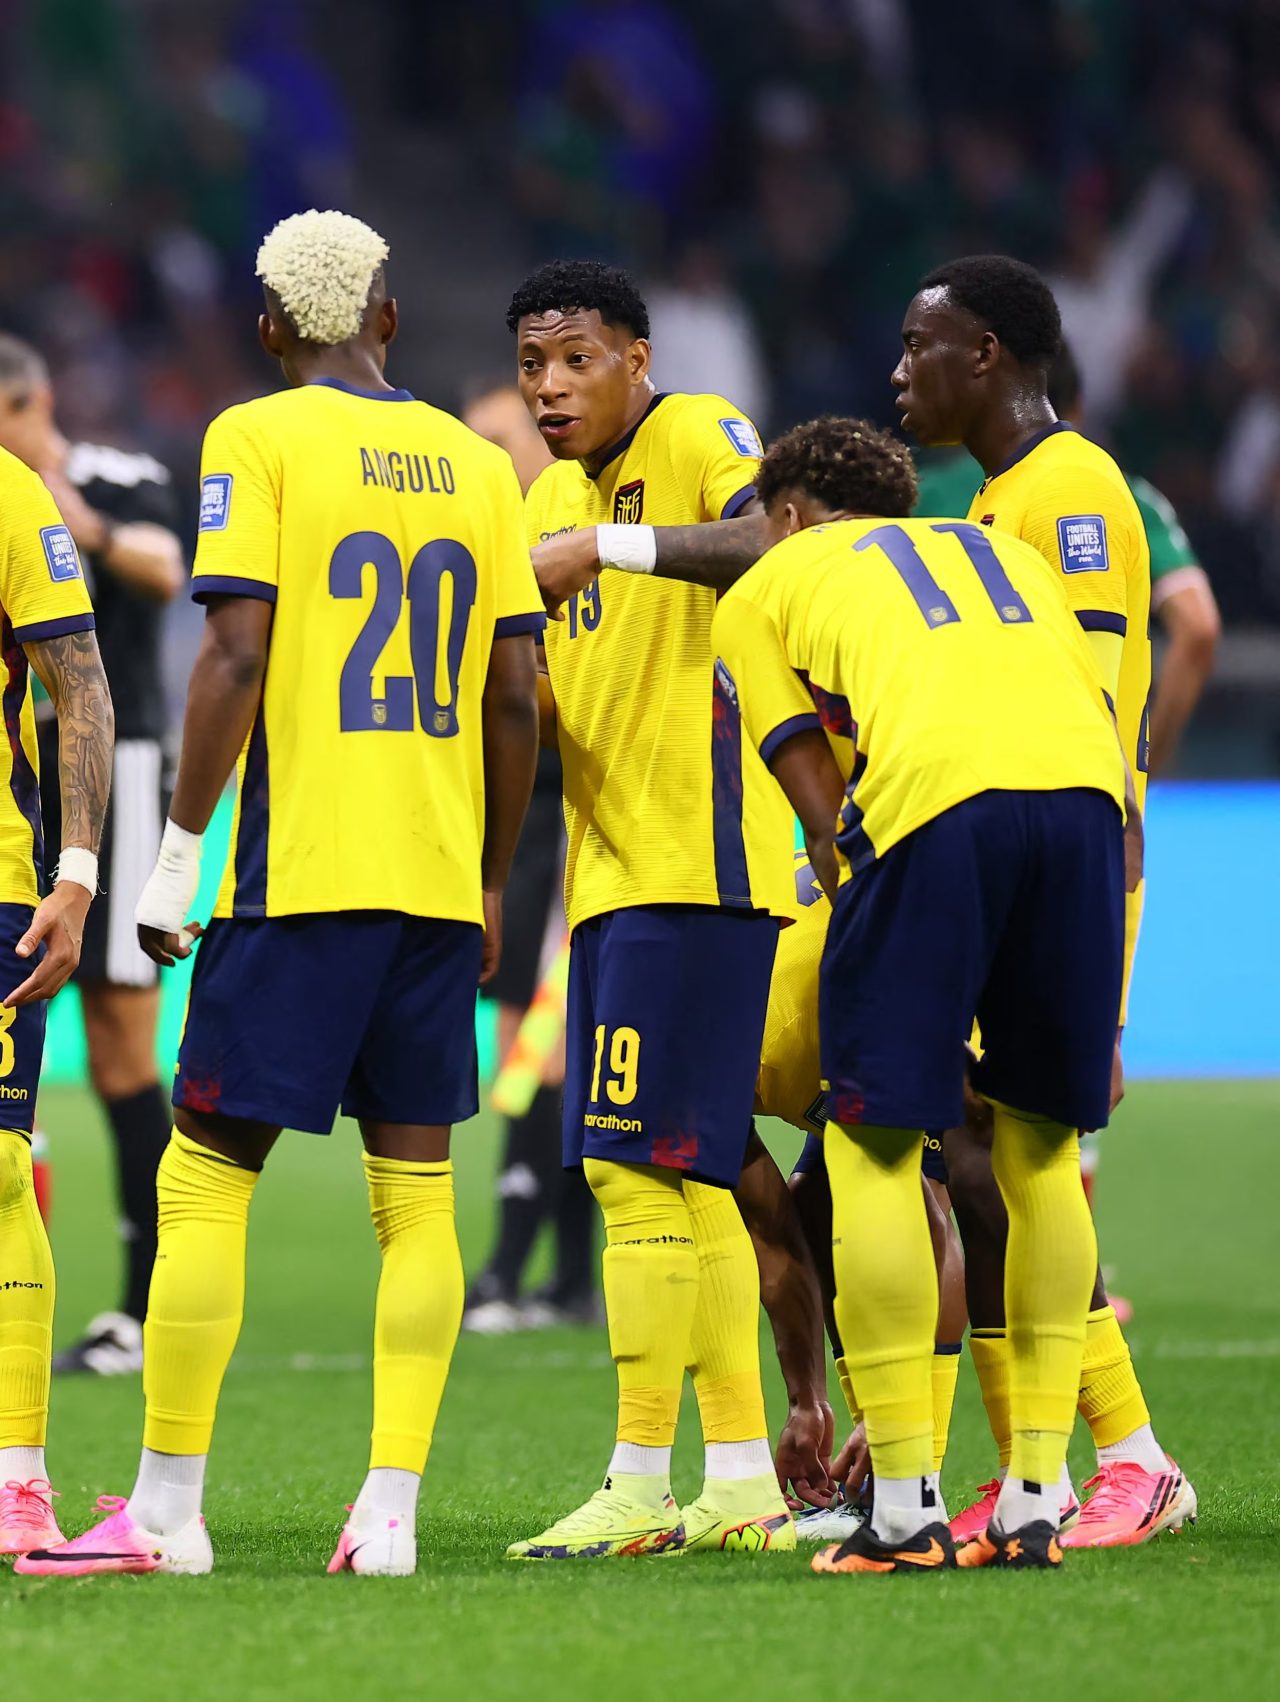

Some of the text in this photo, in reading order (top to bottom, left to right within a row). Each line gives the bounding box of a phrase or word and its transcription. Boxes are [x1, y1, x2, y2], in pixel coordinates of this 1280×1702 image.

[359, 447, 456, 495] ANGULO
[1066, 523, 1098, 535] FOOTBALL
[1067, 533, 1100, 546] UNITES
[851, 523, 1035, 630] 11
[328, 530, 477, 739] 20
[590, 1024, 642, 1105] 19
